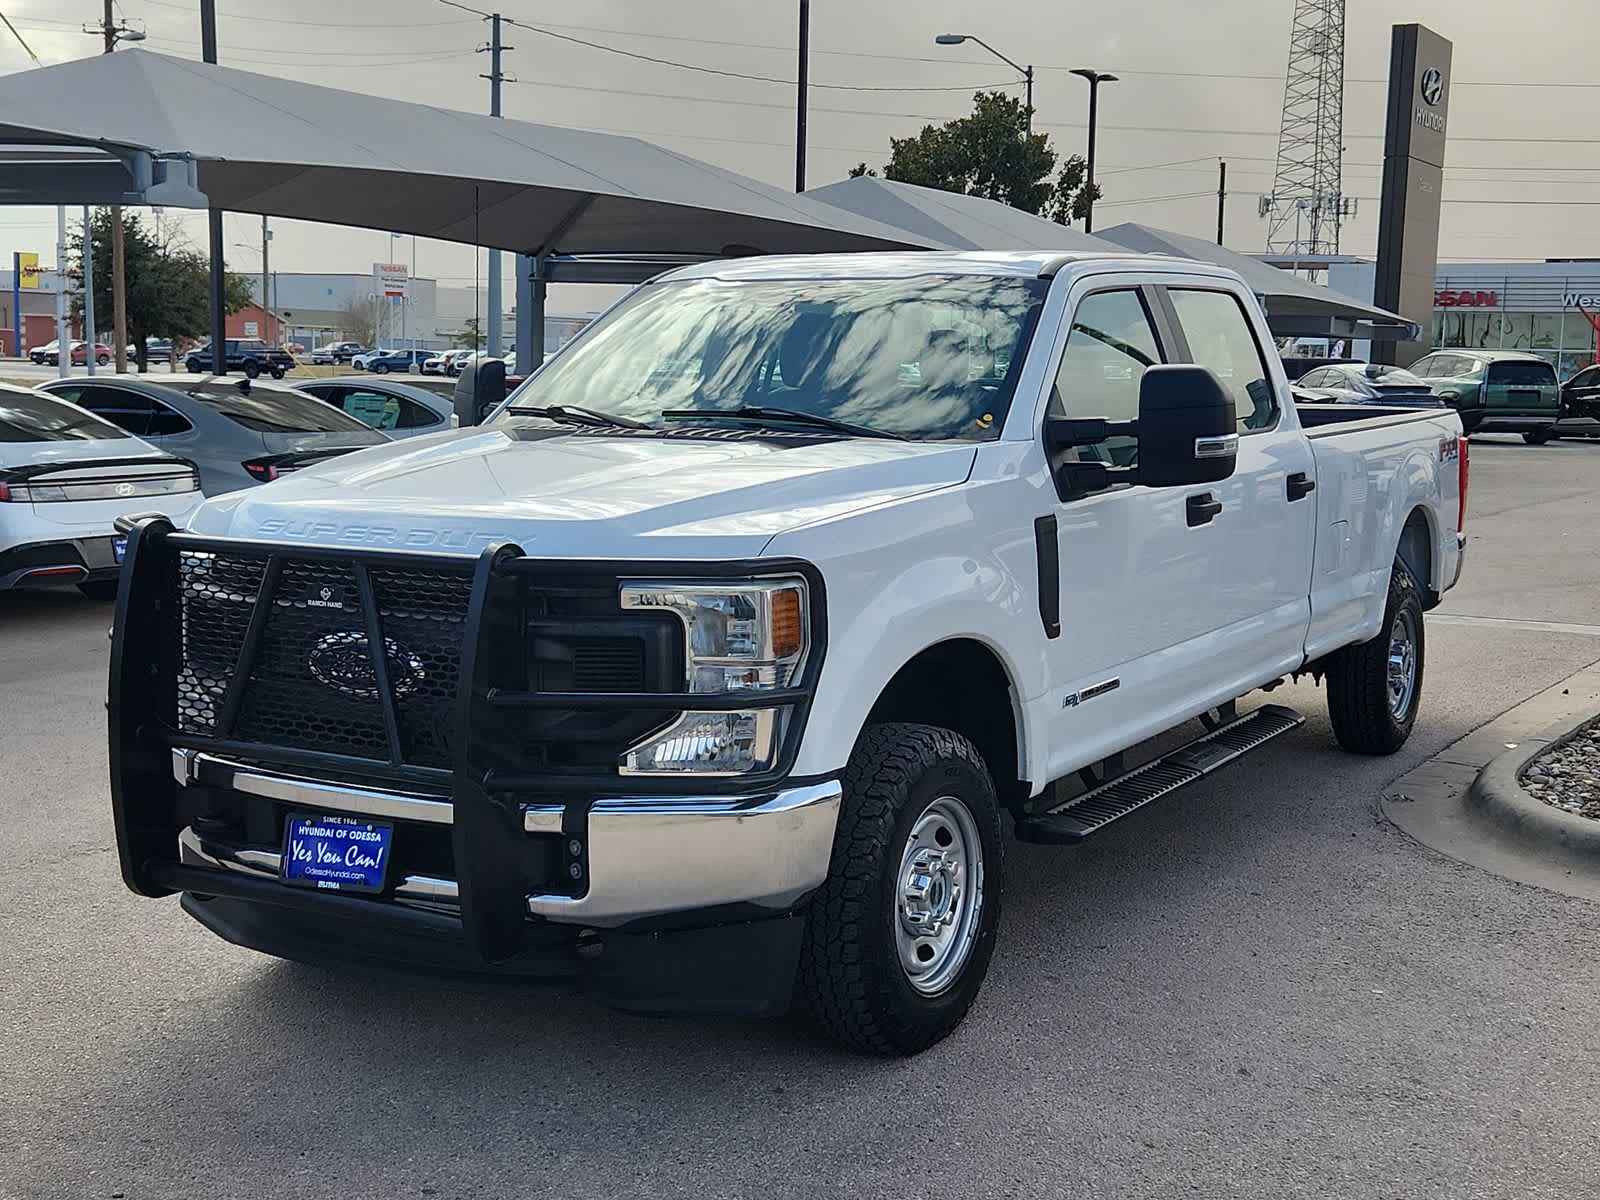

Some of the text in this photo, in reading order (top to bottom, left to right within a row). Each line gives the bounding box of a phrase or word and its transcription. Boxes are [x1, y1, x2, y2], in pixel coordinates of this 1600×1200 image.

[258, 519, 537, 550] SUPER DUTY
[322, 815, 341, 824] SINCE
[298, 826, 382, 842] HYUNDAI OF ODESSA
[292, 839, 384, 869] Yes You Can!
[304, 866, 366, 880] OdessaHyundai.com
